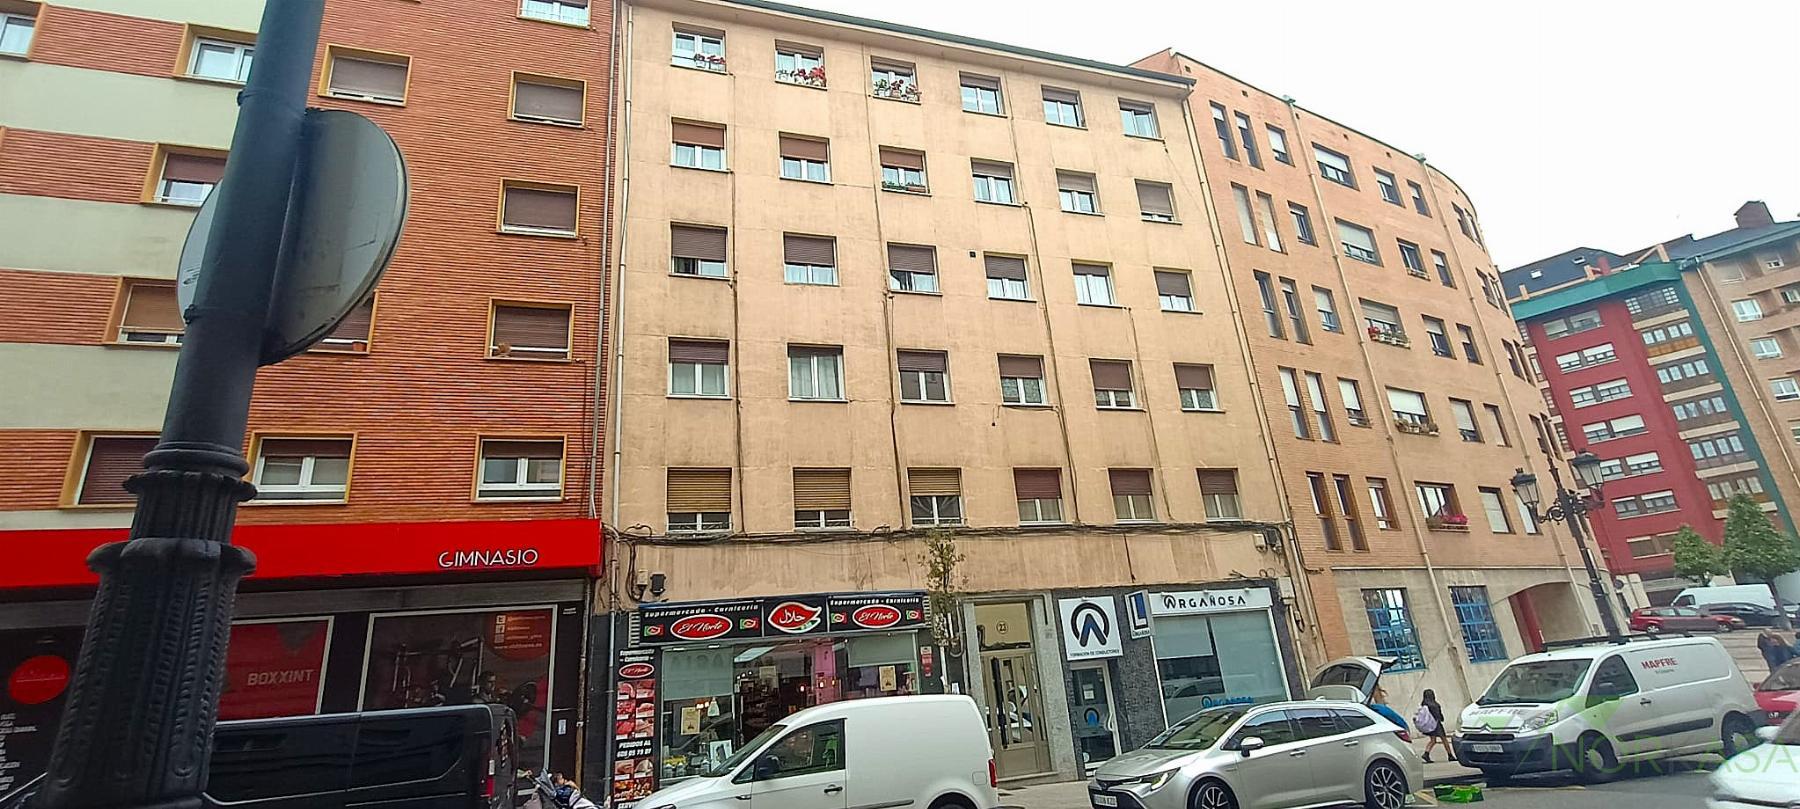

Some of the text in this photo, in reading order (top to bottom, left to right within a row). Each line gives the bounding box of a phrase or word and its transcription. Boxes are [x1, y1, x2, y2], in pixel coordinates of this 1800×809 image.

[438, 549, 539, 568] GIMNASIO
[858, 611, 894, 622] El Norte
[677, 621, 724, 634] El Norte
[1641, 657, 1678, 669] MAPFRE
